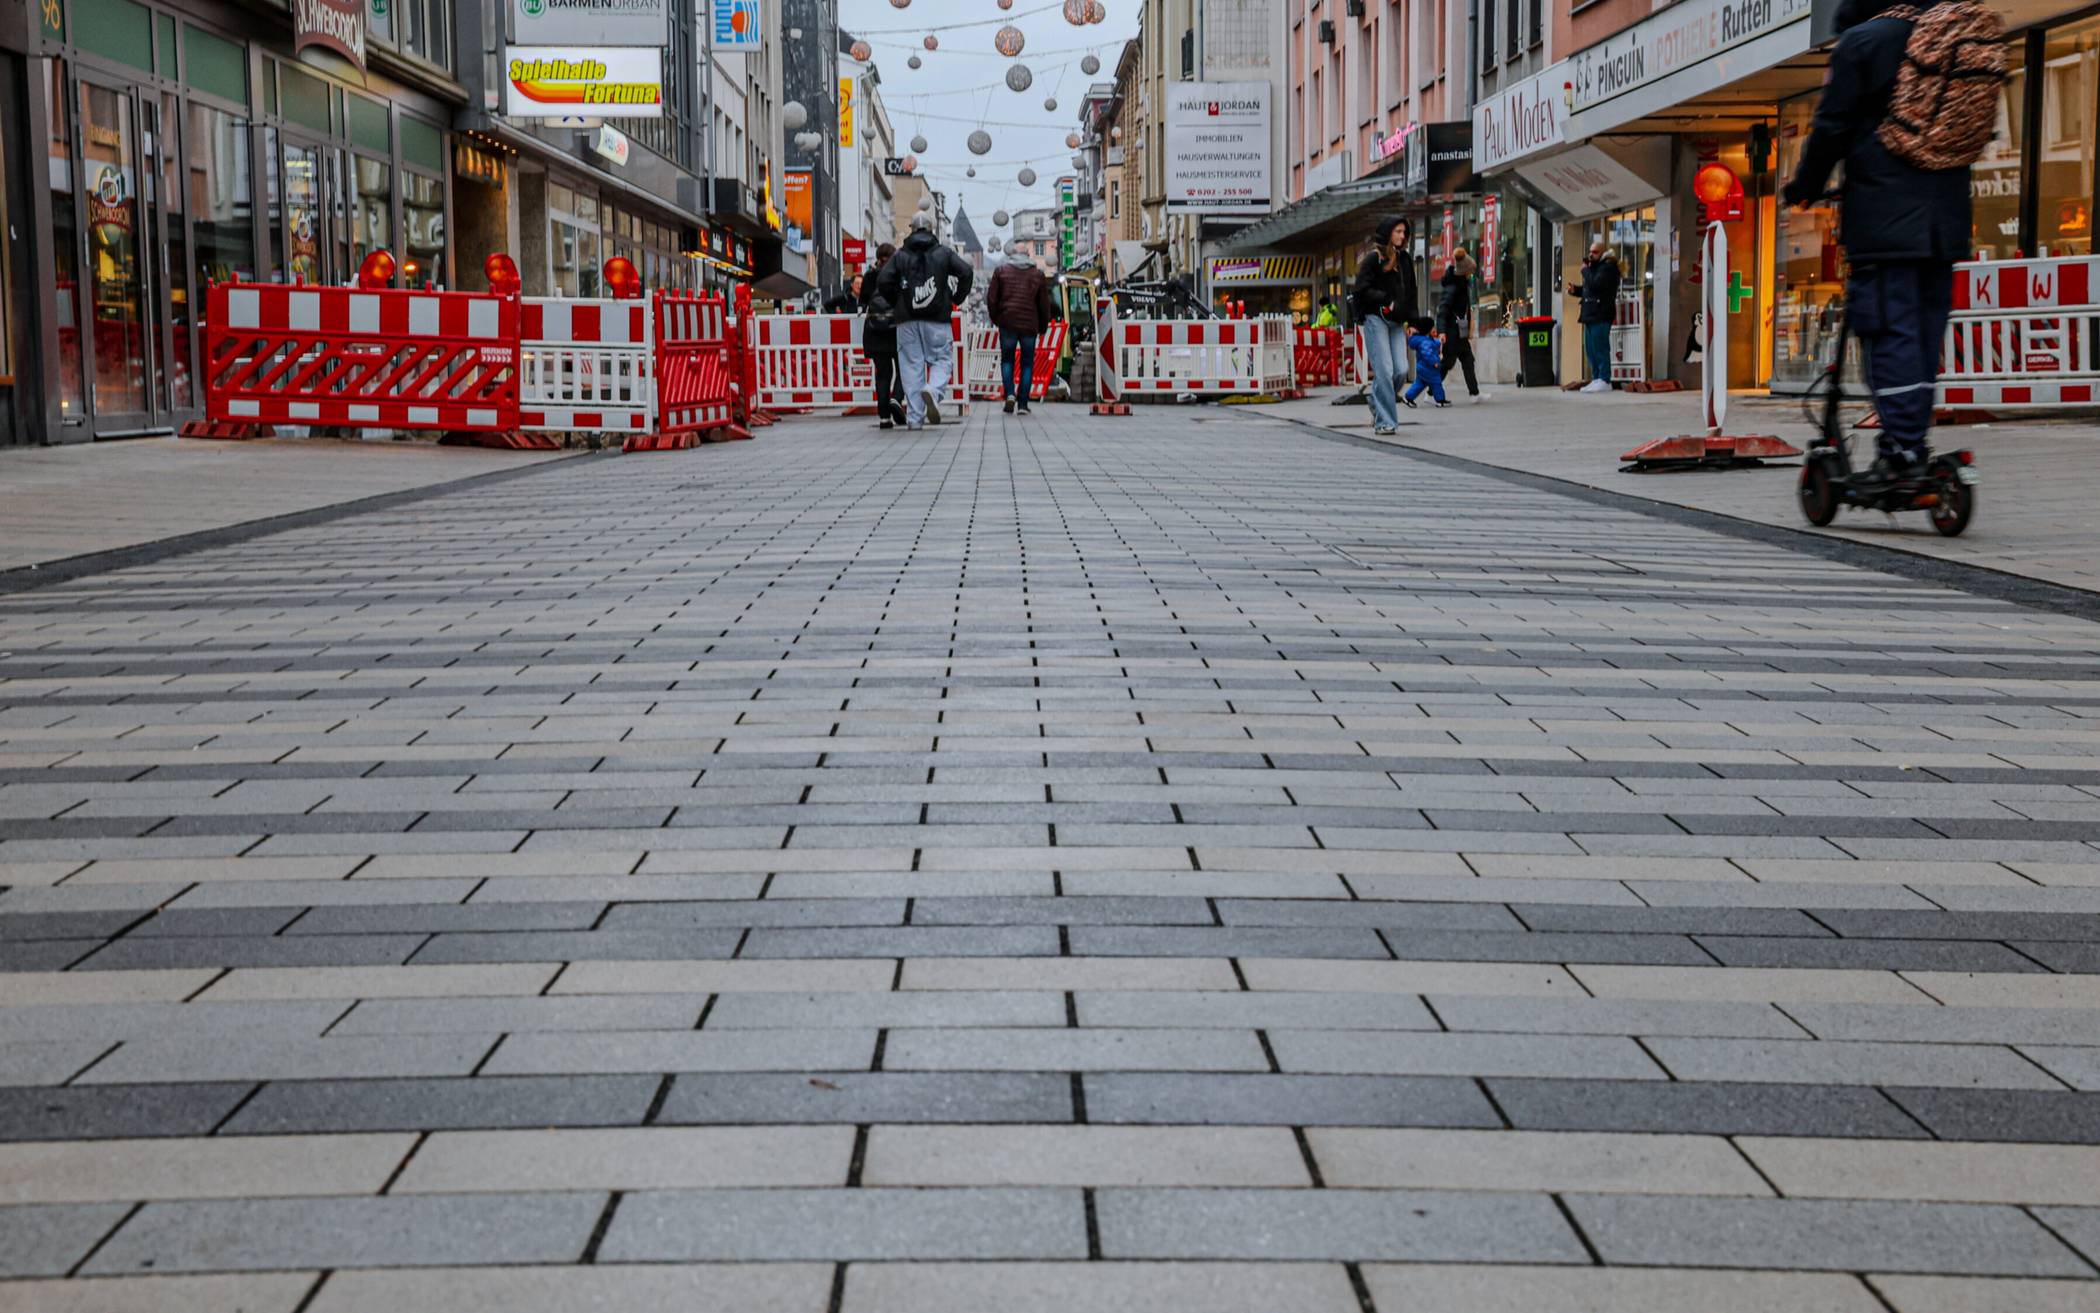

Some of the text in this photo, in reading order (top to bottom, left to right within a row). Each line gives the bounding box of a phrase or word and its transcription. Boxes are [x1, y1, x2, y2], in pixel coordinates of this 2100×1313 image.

[1722, 0, 1771, 43] Rutten
[509, 59, 607, 82] Spielhalle
[584, 83, 657, 104] Fortuna
[1180, 101, 1206, 111] HAUT
[1220, 101, 1260, 111] JORDAN
[1177, 153, 1261, 161] HAUSVERWALTUNGEN
[1176, 170, 1262, 179] HAUSMEISTERSERVICE
[915, 276, 936, 302] NIKE
[1977, 273, 2051, 304] K W
[1532, 334, 1545, 343] 50
